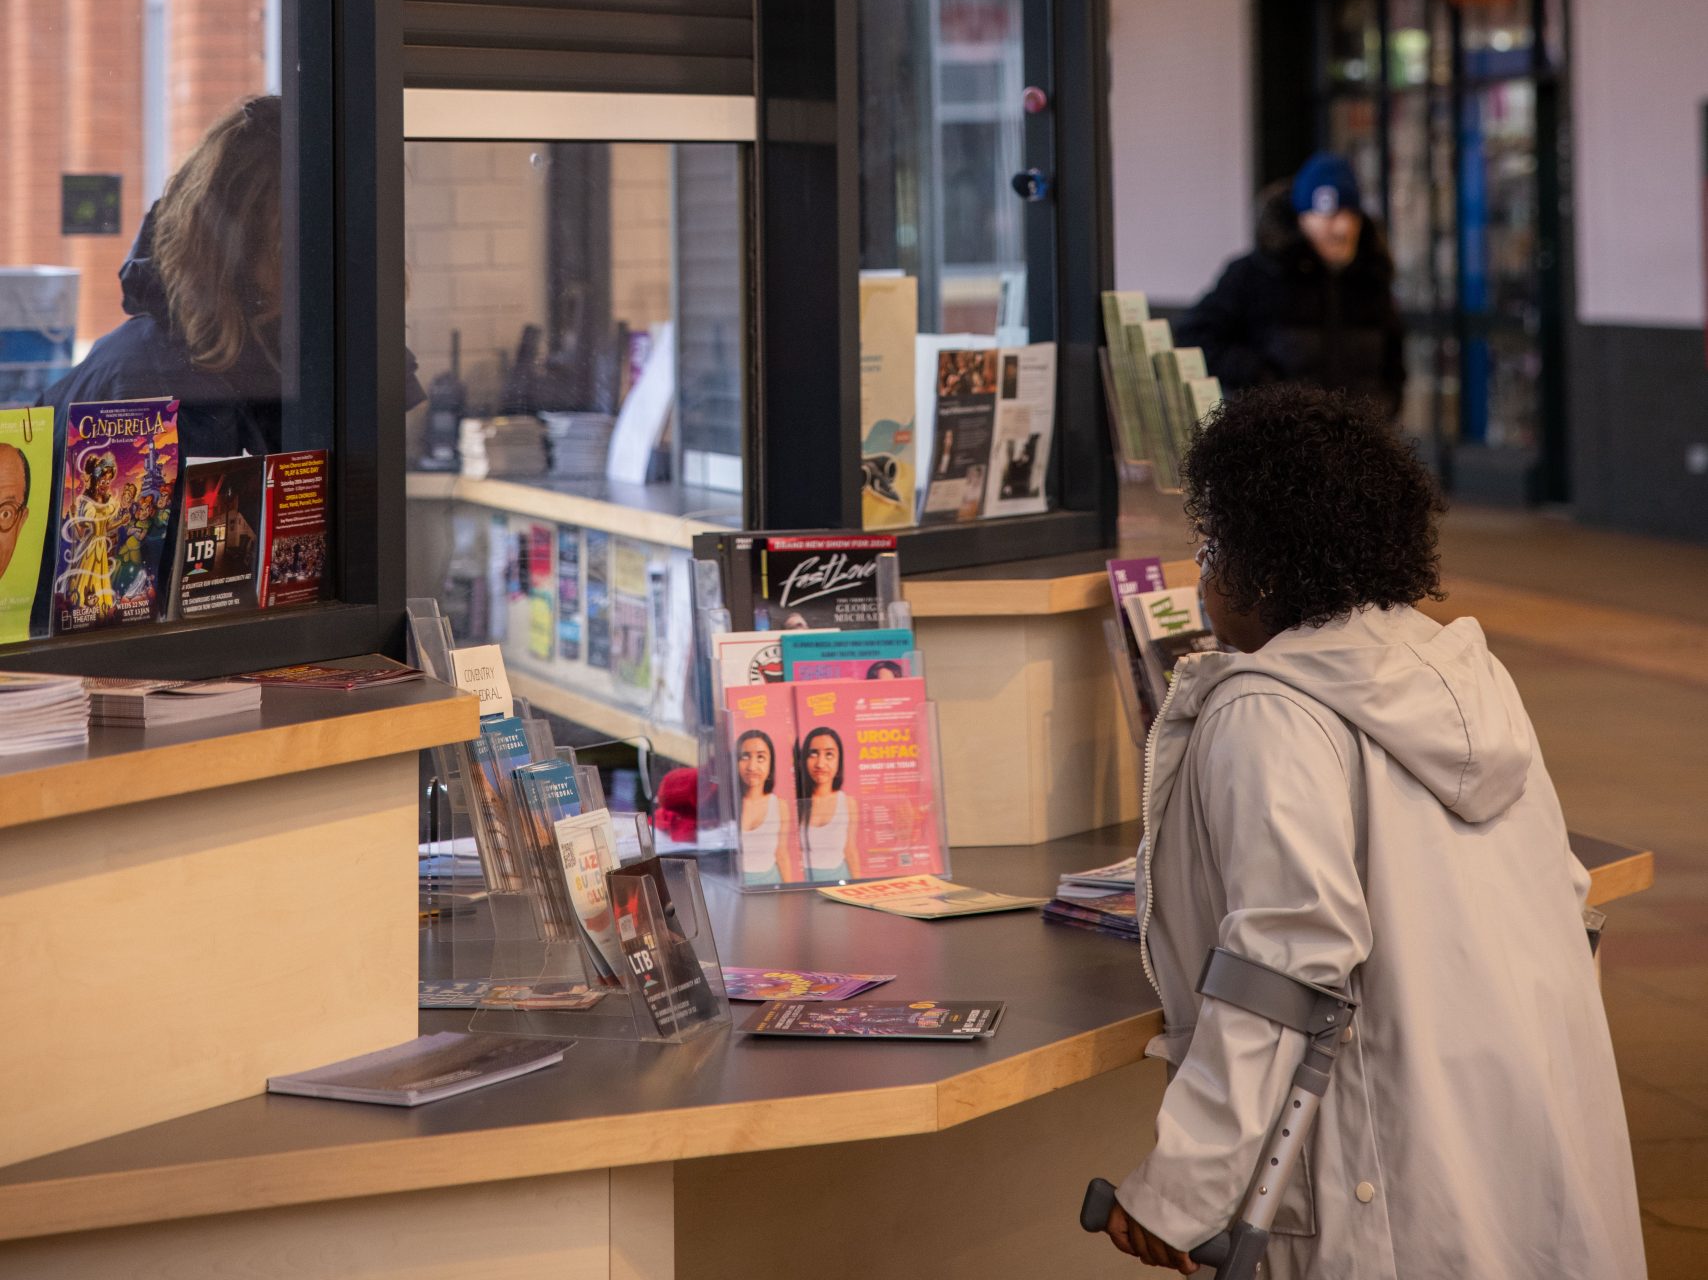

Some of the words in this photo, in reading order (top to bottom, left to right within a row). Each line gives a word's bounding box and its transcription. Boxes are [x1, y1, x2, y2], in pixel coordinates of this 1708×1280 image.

[79, 411, 167, 439] CINDERELLA
[187, 540, 215, 562] LTB
[806, 540, 824, 548] NEW
[825, 540, 850, 548] SHOW
[852, 539, 868, 547] FOR
[73, 607, 100, 617] BELGRADE
[116, 601, 132, 610] WEDS
[140, 599, 150, 607] NOV
[123, 608, 134, 617] SAT
[140, 607, 150, 616] JAN
[73, 613, 97, 624] THEATRE
[464, 667, 496, 683] COVENTRY
[856, 728, 911, 744] UROOJ
[836, 879, 930, 897] DIPPY
[628, 950, 654, 975] LTB
